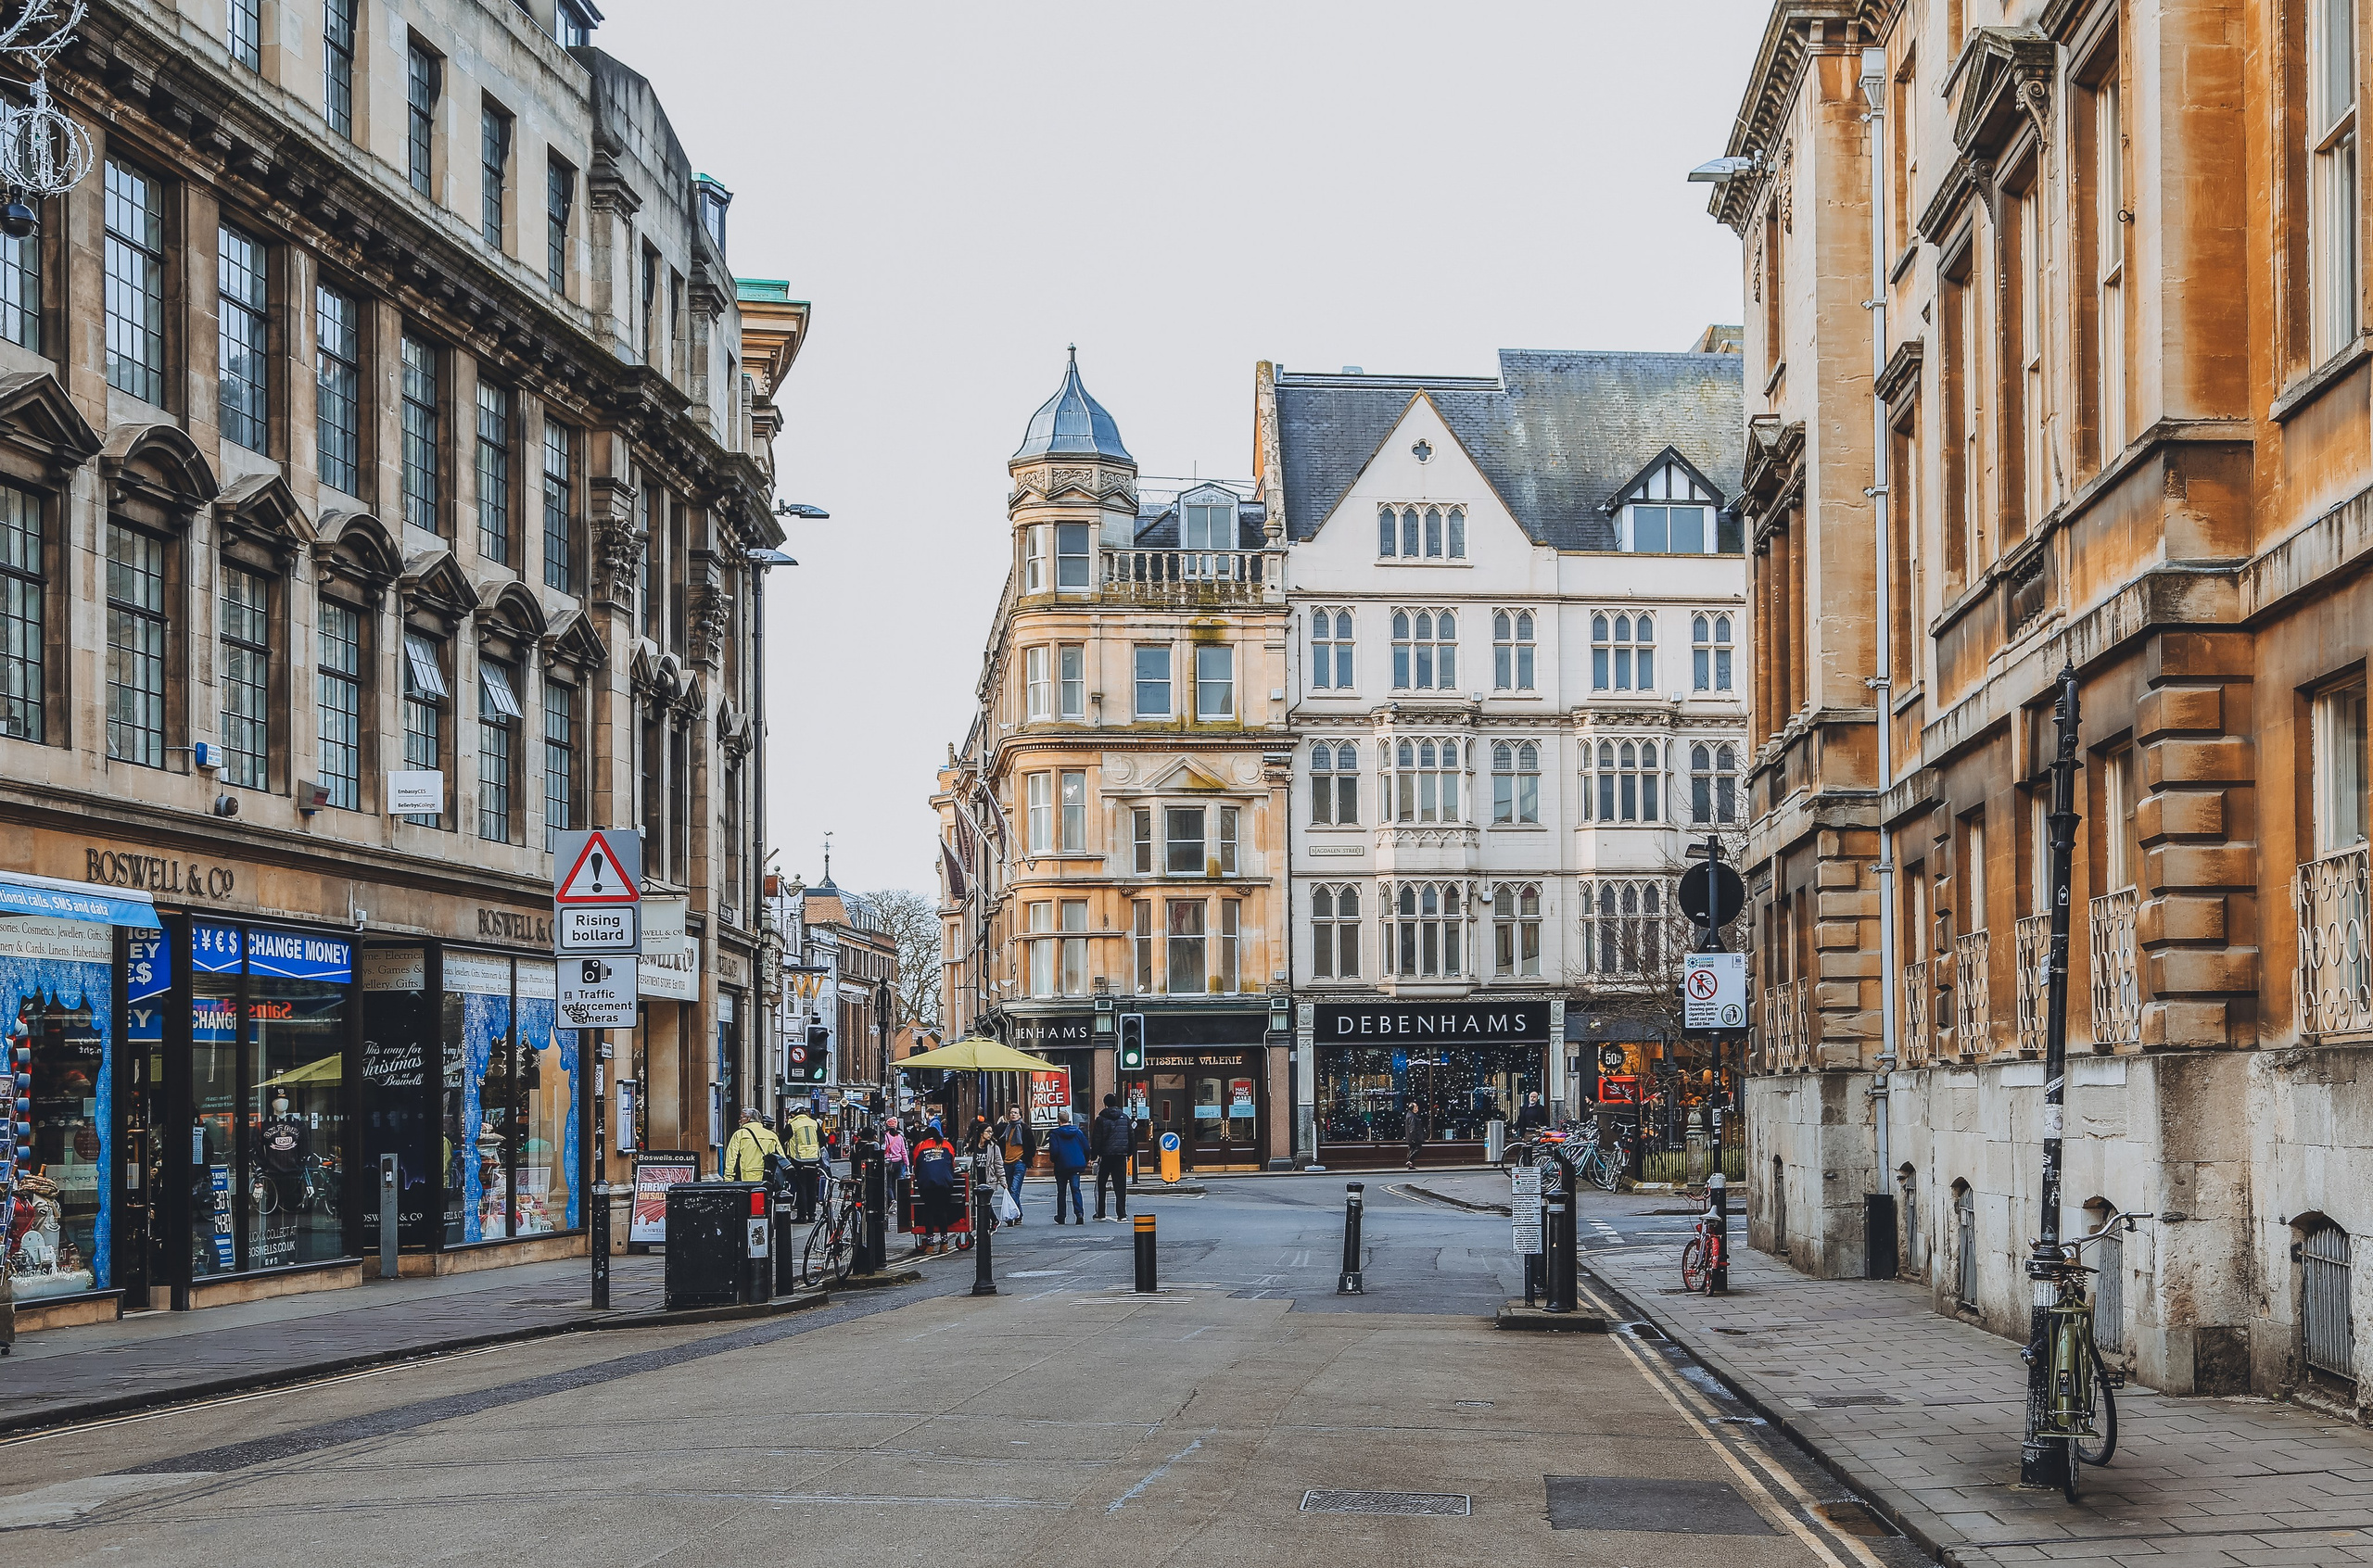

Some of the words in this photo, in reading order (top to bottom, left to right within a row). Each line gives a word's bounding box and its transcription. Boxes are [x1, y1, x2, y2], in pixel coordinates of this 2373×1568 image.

[86, 847, 184, 893] BOSWELL
[187, 864, 207, 897] &
[0, 889, 27, 904] tional
[27, 893, 54, 911] calls,
[52, 896, 73, 912] SMS
[74, 899, 90, 914] and
[90, 902, 109, 916] data
[477, 907, 536, 940] BOSWELL
[535, 917, 547, 941] &
[576, 914, 620, 928] Rising
[0, 923, 20, 933] sories.
[21, 921, 57, 936] Cosmetics.
[57, 925, 85, 940] Jewellery.
[87, 928, 104, 941] Gifts.
[572, 929, 624, 942] bollard
[130, 942, 161, 958] EY
[215, 930, 225, 952] €
[228, 930, 237, 956] $
[248, 933, 302, 960] CHANGE
[305, 940, 349, 965] MONEY
[0, 942, 14, 953] nery
[17, 941, 23, 953] &
[25, 941, 46, 955] Cards.
[48, 943, 70, 956] Linens.
[72, 944, 113, 961] Haberdashery
[362, 967, 374, 976] ys.
[378, 965, 410, 974] Games
[413, 964, 423, 974] &
[395, 979, 421, 988] Gifts.
[578, 989, 615, 999] Traffic
[562, 1001, 633, 1012] enforcement
[1337, 1013, 1527, 1034] DEBENHAMS
[362, 1040, 380, 1056] This
[383, 1046, 406, 1059] way
[402, 1042, 425, 1059] for
[1199, 1056, 1243, 1065] VALERIE
[1605, 1053, 1617, 1064] 50
[1033, 1080, 1060, 1092] HALF
[1034, 1092, 1064, 1105] PRICE
[266, 1226, 289, 1240] COLLECT
